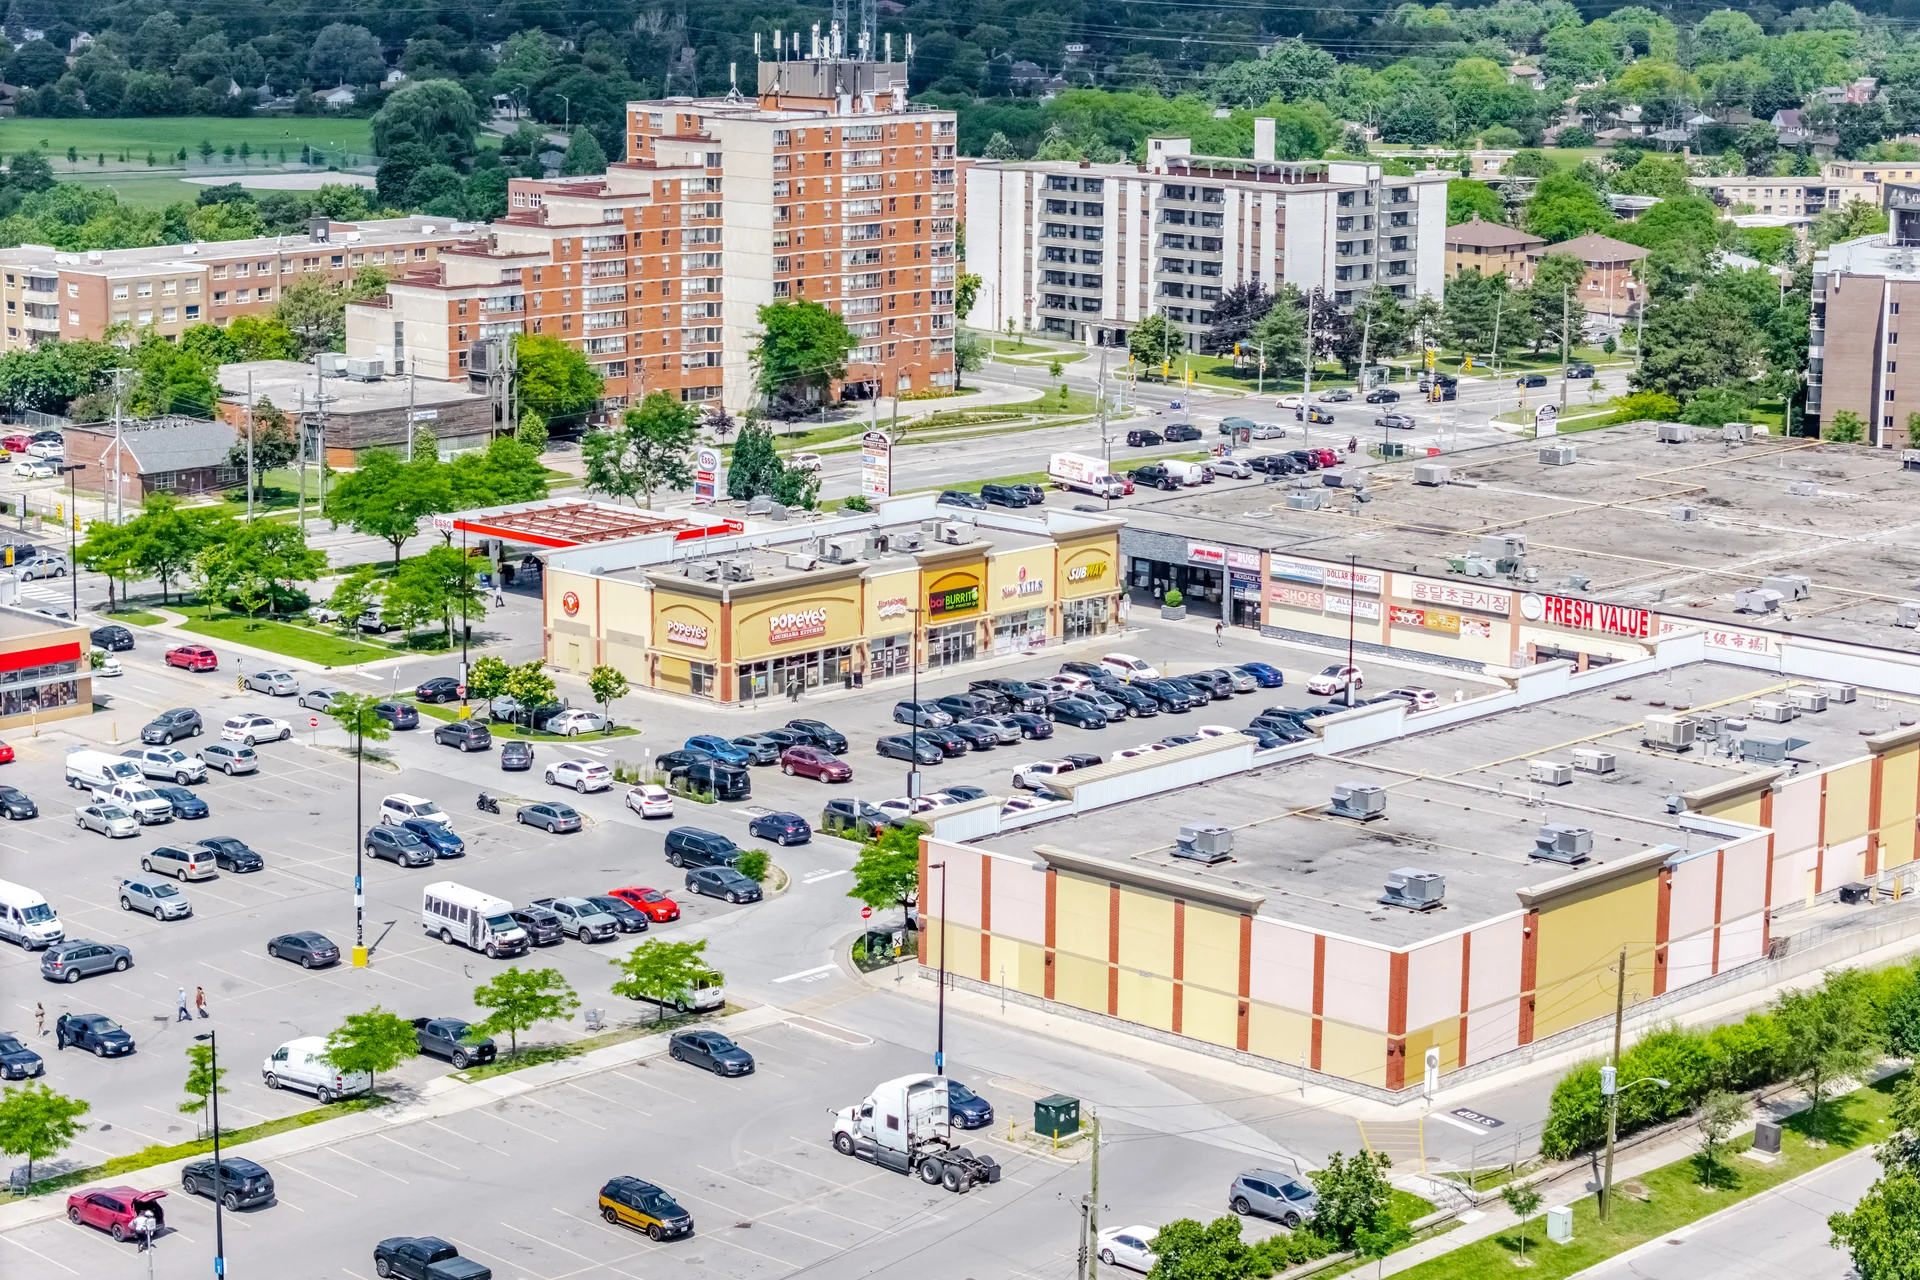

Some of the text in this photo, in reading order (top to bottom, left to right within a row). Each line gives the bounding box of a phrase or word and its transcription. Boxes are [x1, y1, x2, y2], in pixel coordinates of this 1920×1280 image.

[1237, 553, 1259, 566] RUGS
[1068, 561, 1107, 581] SUBWAY
[1326, 569, 1349, 581] DOLLAR
[1283, 588, 1320, 604] SHOES
[1353, 601, 1373, 610] STAR
[1545, 595, 1649, 637] FRESH VALUE
[771, 626, 824, 641] LOUISIANA KITCHEN
[1456, 1111, 1496, 1126] STOP
